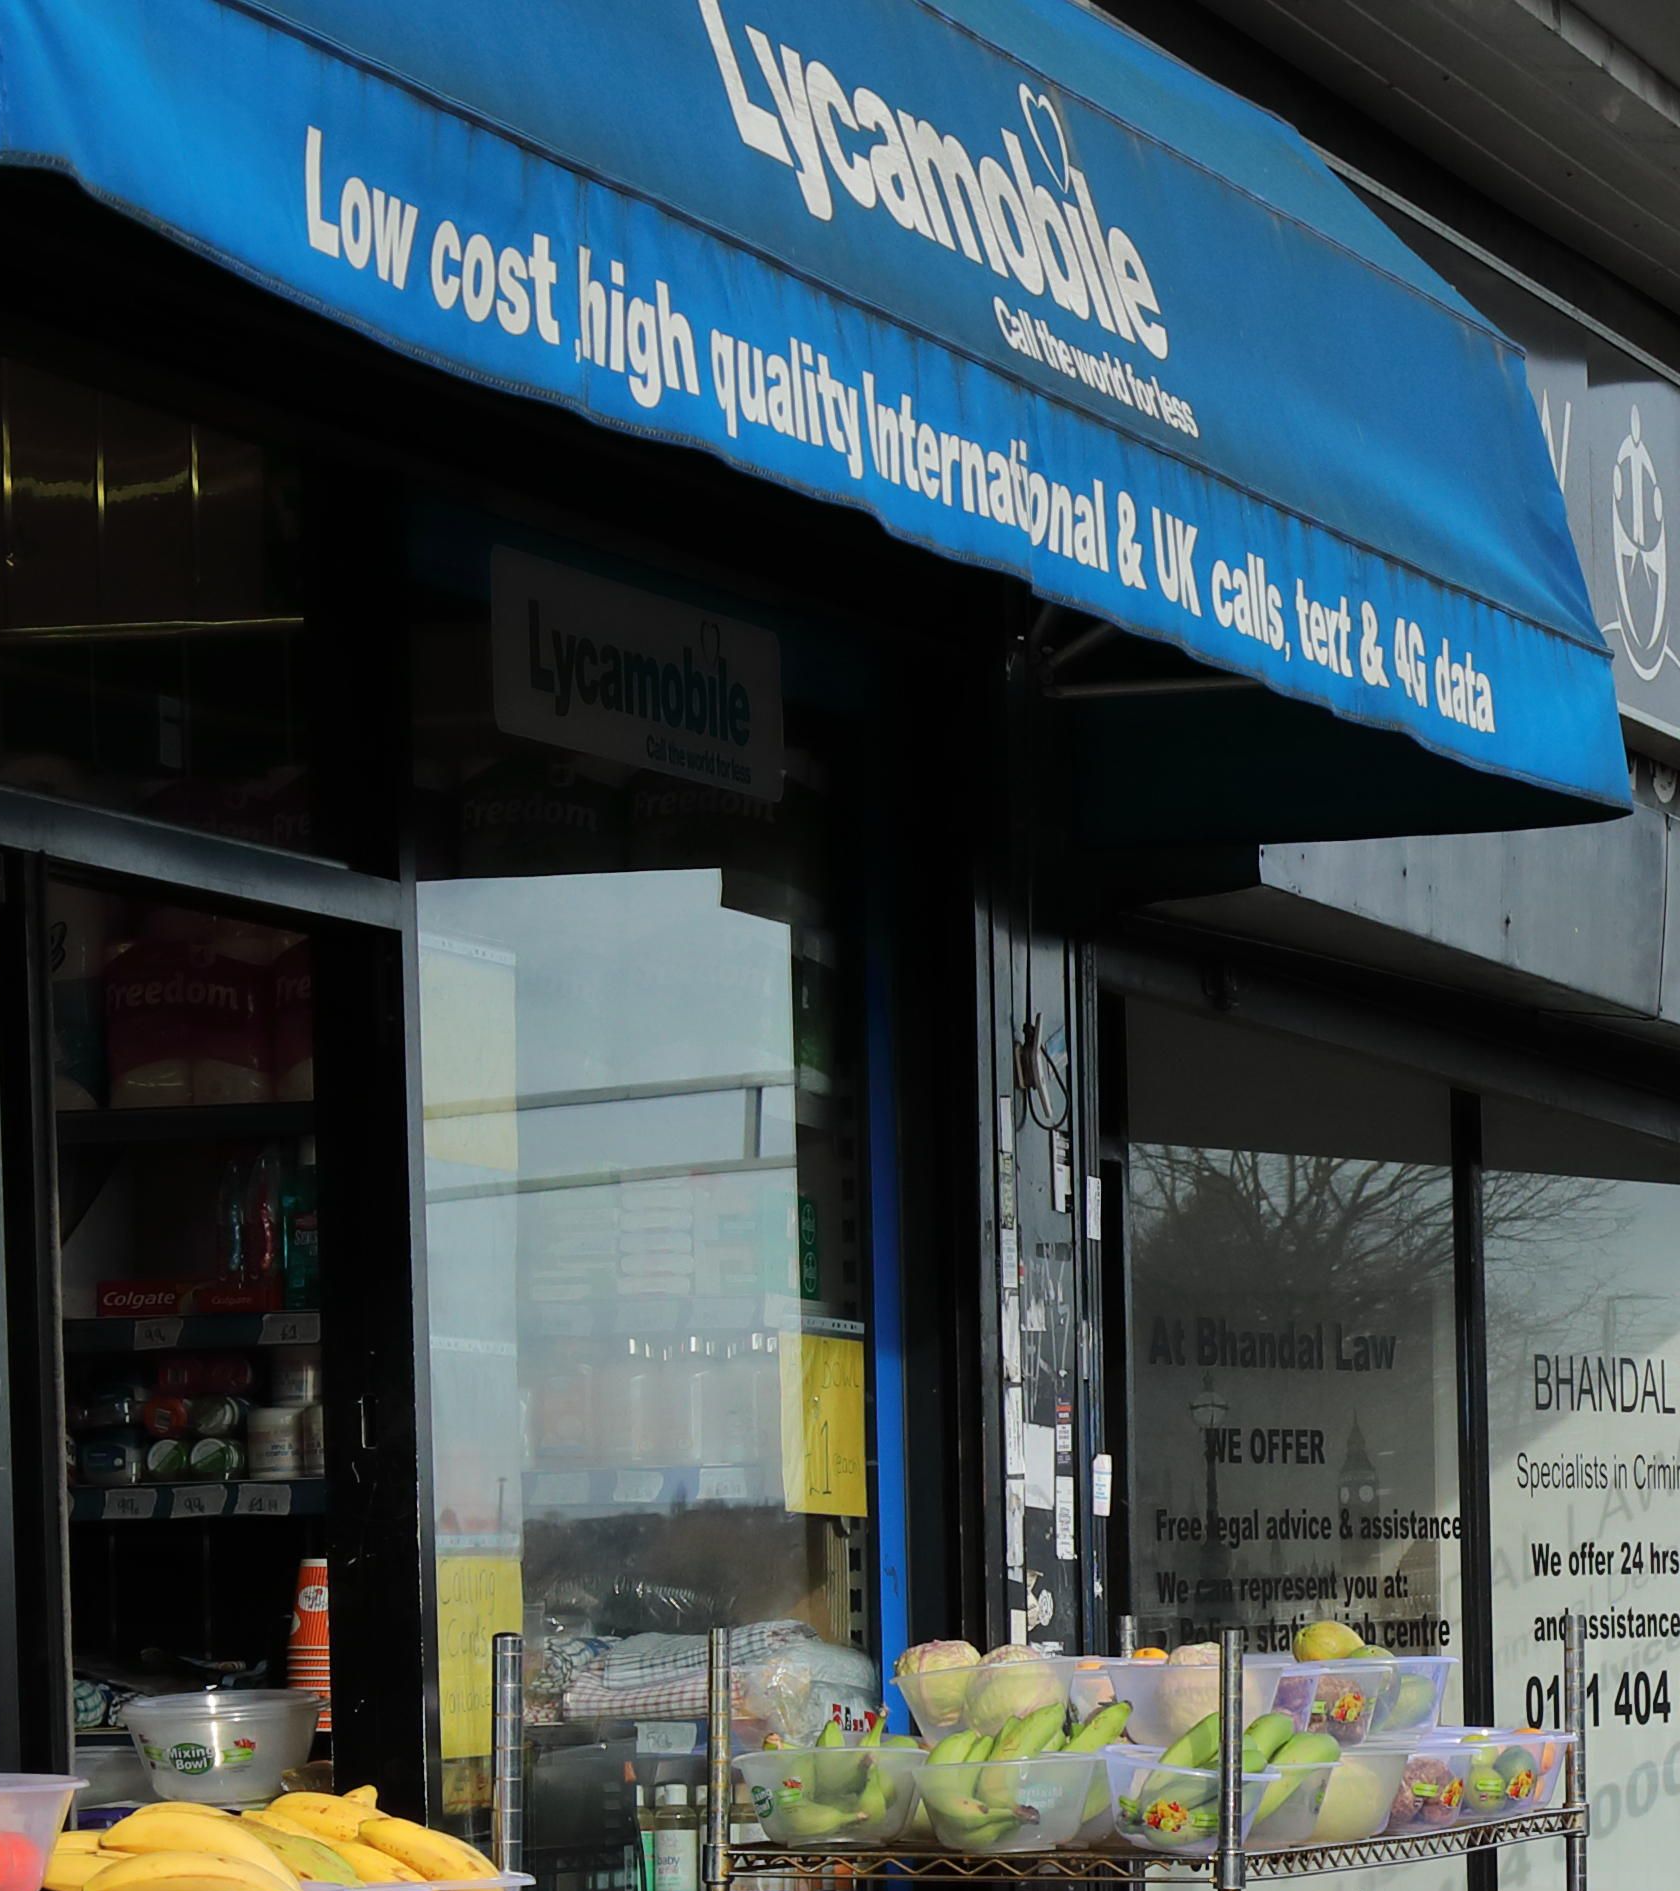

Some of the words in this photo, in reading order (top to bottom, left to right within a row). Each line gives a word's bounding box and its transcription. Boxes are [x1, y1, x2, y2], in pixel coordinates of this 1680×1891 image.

[699, 0, 1169, 359] Lycamobile
[993, 297, 1038, 355] Call
[1040, 316, 1075, 372] the
[1072, 330, 1131, 408] world
[1124, 362, 1160, 418] for
[1158, 376, 1199, 438] less
[305, 126, 419, 293] Low
[430, 208, 561, 345] cost
[710, 323, 860, 481] quality
[860, 372, 1108, 574] International
[1117, 490, 1147, 588] &
[1150, 503, 1202, 618] UK
[1210, 547, 1294, 665] calls,
[1296, 599, 1355, 684] text
[1360, 604, 1388, 689] &
[1392, 618, 1429, 711] 4G
[1432, 629, 1497, 735] data
[529, 599, 752, 746] Lycamobile
[105, 972, 239, 1015] freedom
[102, 1291, 175, 1310] Colgate
[1149, 1316, 1185, 1364] At
[1196, 1318, 1322, 1370] Bhandal
[1334, 1321, 1396, 1372] Law
[1533, 1355, 1678, 1415] BHANDAL
[1204, 1428, 1244, 1465] WE
[1250, 1428, 1326, 1466] OFFER
[1516, 1452, 1610, 1493] Specialists
[1614, 1454, 1629, 1489] in
[1156, 1509, 1206, 1543] Free
[1266, 1511, 1331, 1542] advice
[1340, 1511, 1356, 1542] &
[1360, 1513, 1462, 1543] assistance
[1532, 1543, 1564, 1577] We
[1568, 1542, 1616, 1577] offer
[1619, 1544, 1645, 1577] 24
[1649, 1543, 1680, 1575] hrs
[1157, 1571, 1189, 1602] We
[1240, 1572, 1338, 1609] represent
[1343, 1578, 1379, 1609] you
[1383, 1570, 1409, 1600] at:
[1387, 1618, 1450, 1650] centre
[1526, 1671, 1601, 1731] 011
[1614, 1670, 1670, 1729] 404
[170, 1747, 213, 1761] Mixing
[175, 1758, 208, 1770] Bowl
